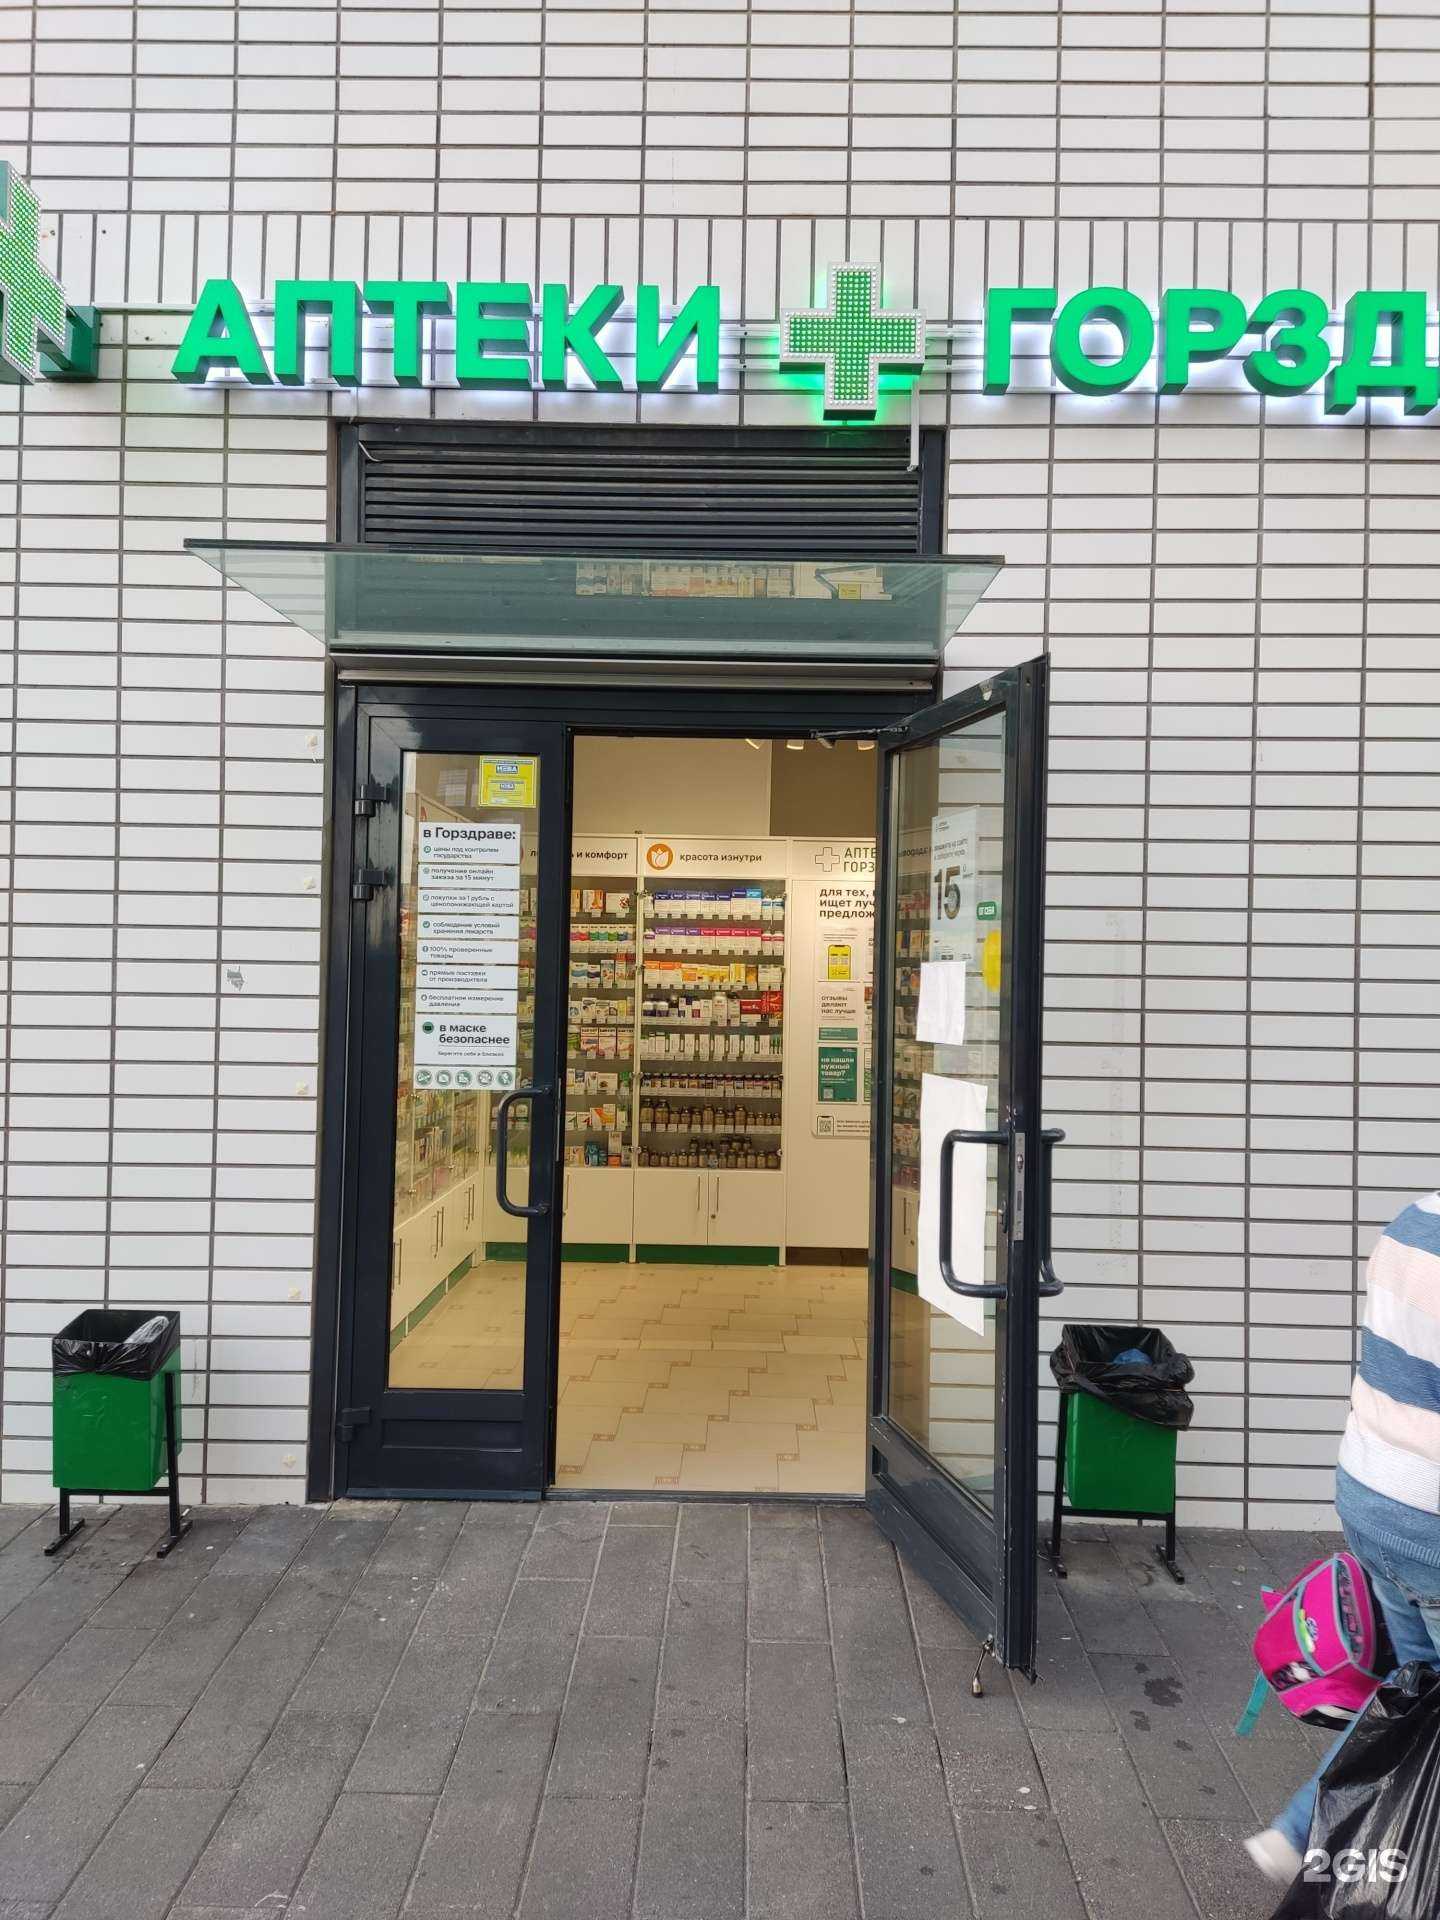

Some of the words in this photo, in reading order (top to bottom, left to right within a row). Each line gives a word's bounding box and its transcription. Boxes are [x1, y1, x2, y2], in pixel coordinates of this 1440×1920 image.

[171, 279, 720, 394] АПТЕКИ
[983, 287, 1440, 415] ГОРЗД
[423, 829, 431, 838] в
[436, 827, 516, 841] Горздраве:
[585, 850, 628, 862] комфорт
[680, 853, 719, 862] красота
[721, 853, 763, 863] изнутри
[843, 862, 876, 873] ГОРЗ
[819, 888, 842, 898] для
[846, 889, 869, 898] тех,
[934, 865, 960, 921] 15
[820, 899, 854, 909] ищет
[439, 1024, 447, 1032] в
[449, 1024, 487, 1033] маске
[439, 1033, 510, 1044] безопаснее
